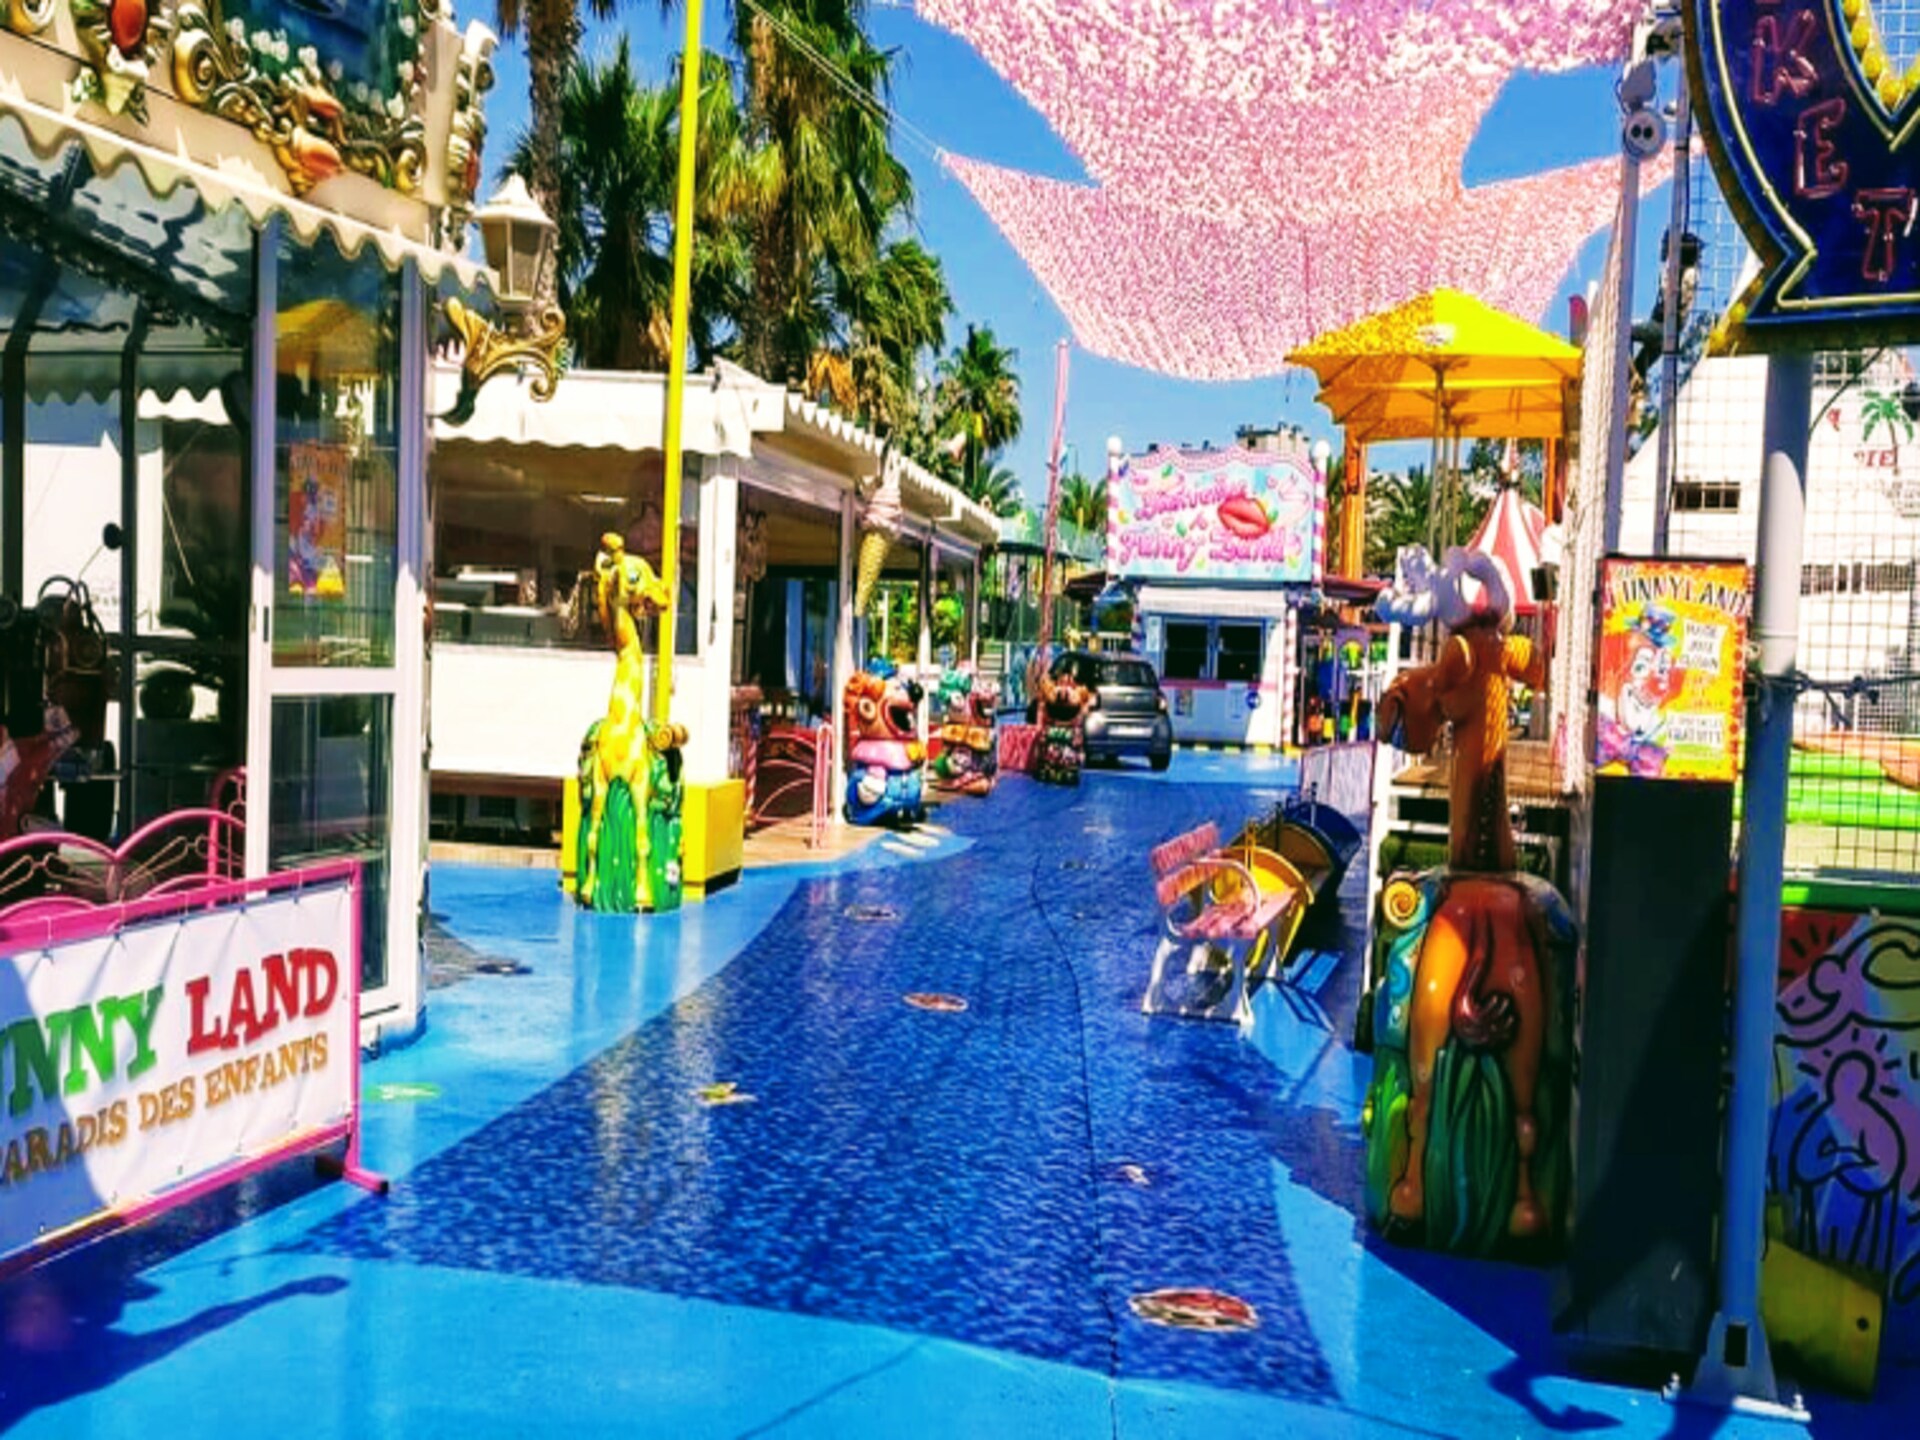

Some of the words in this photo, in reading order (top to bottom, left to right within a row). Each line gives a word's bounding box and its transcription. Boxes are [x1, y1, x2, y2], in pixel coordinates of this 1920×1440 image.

[1752, 2, 1918, 282] KET
[0, 983, 164, 1118] NNY
[185, 947, 339, 1056] LAND
[0, 1099, 128, 1185] ARADIS
[138, 1075, 195, 1132] DES
[205, 1031, 329, 1107] ENFANTS
